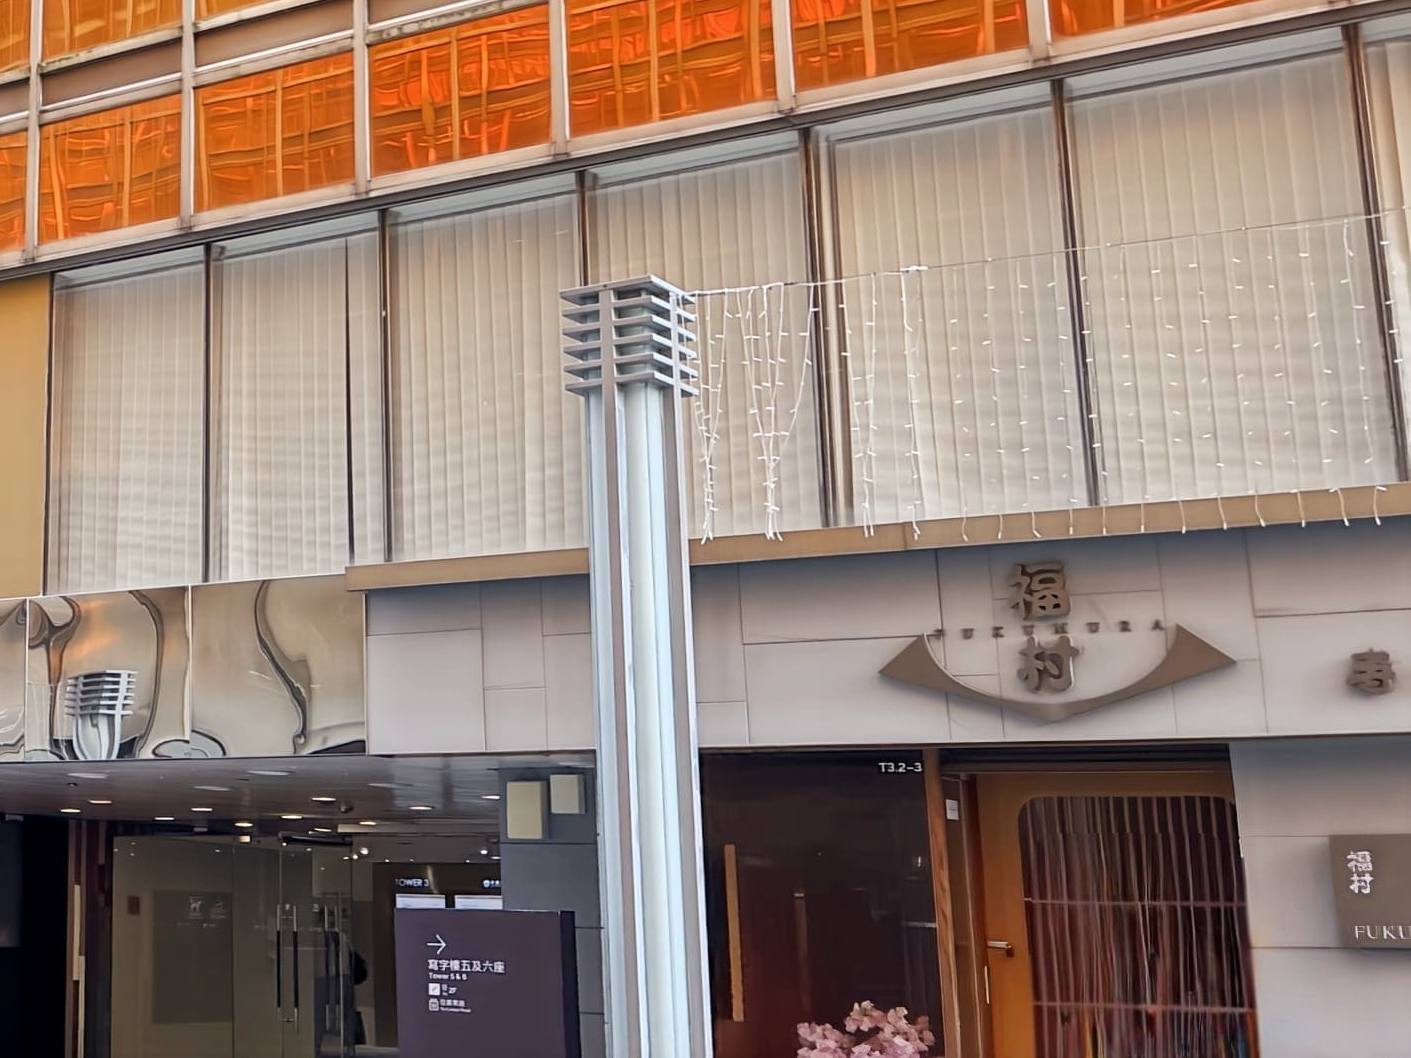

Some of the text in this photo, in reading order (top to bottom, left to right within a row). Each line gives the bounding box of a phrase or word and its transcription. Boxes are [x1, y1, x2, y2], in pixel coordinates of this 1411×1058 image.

[878, 762, 923, 773] T3.2-3
[1346, 850, 1374, 894] 福村
[395, 878, 430, 887] TOWER 3
